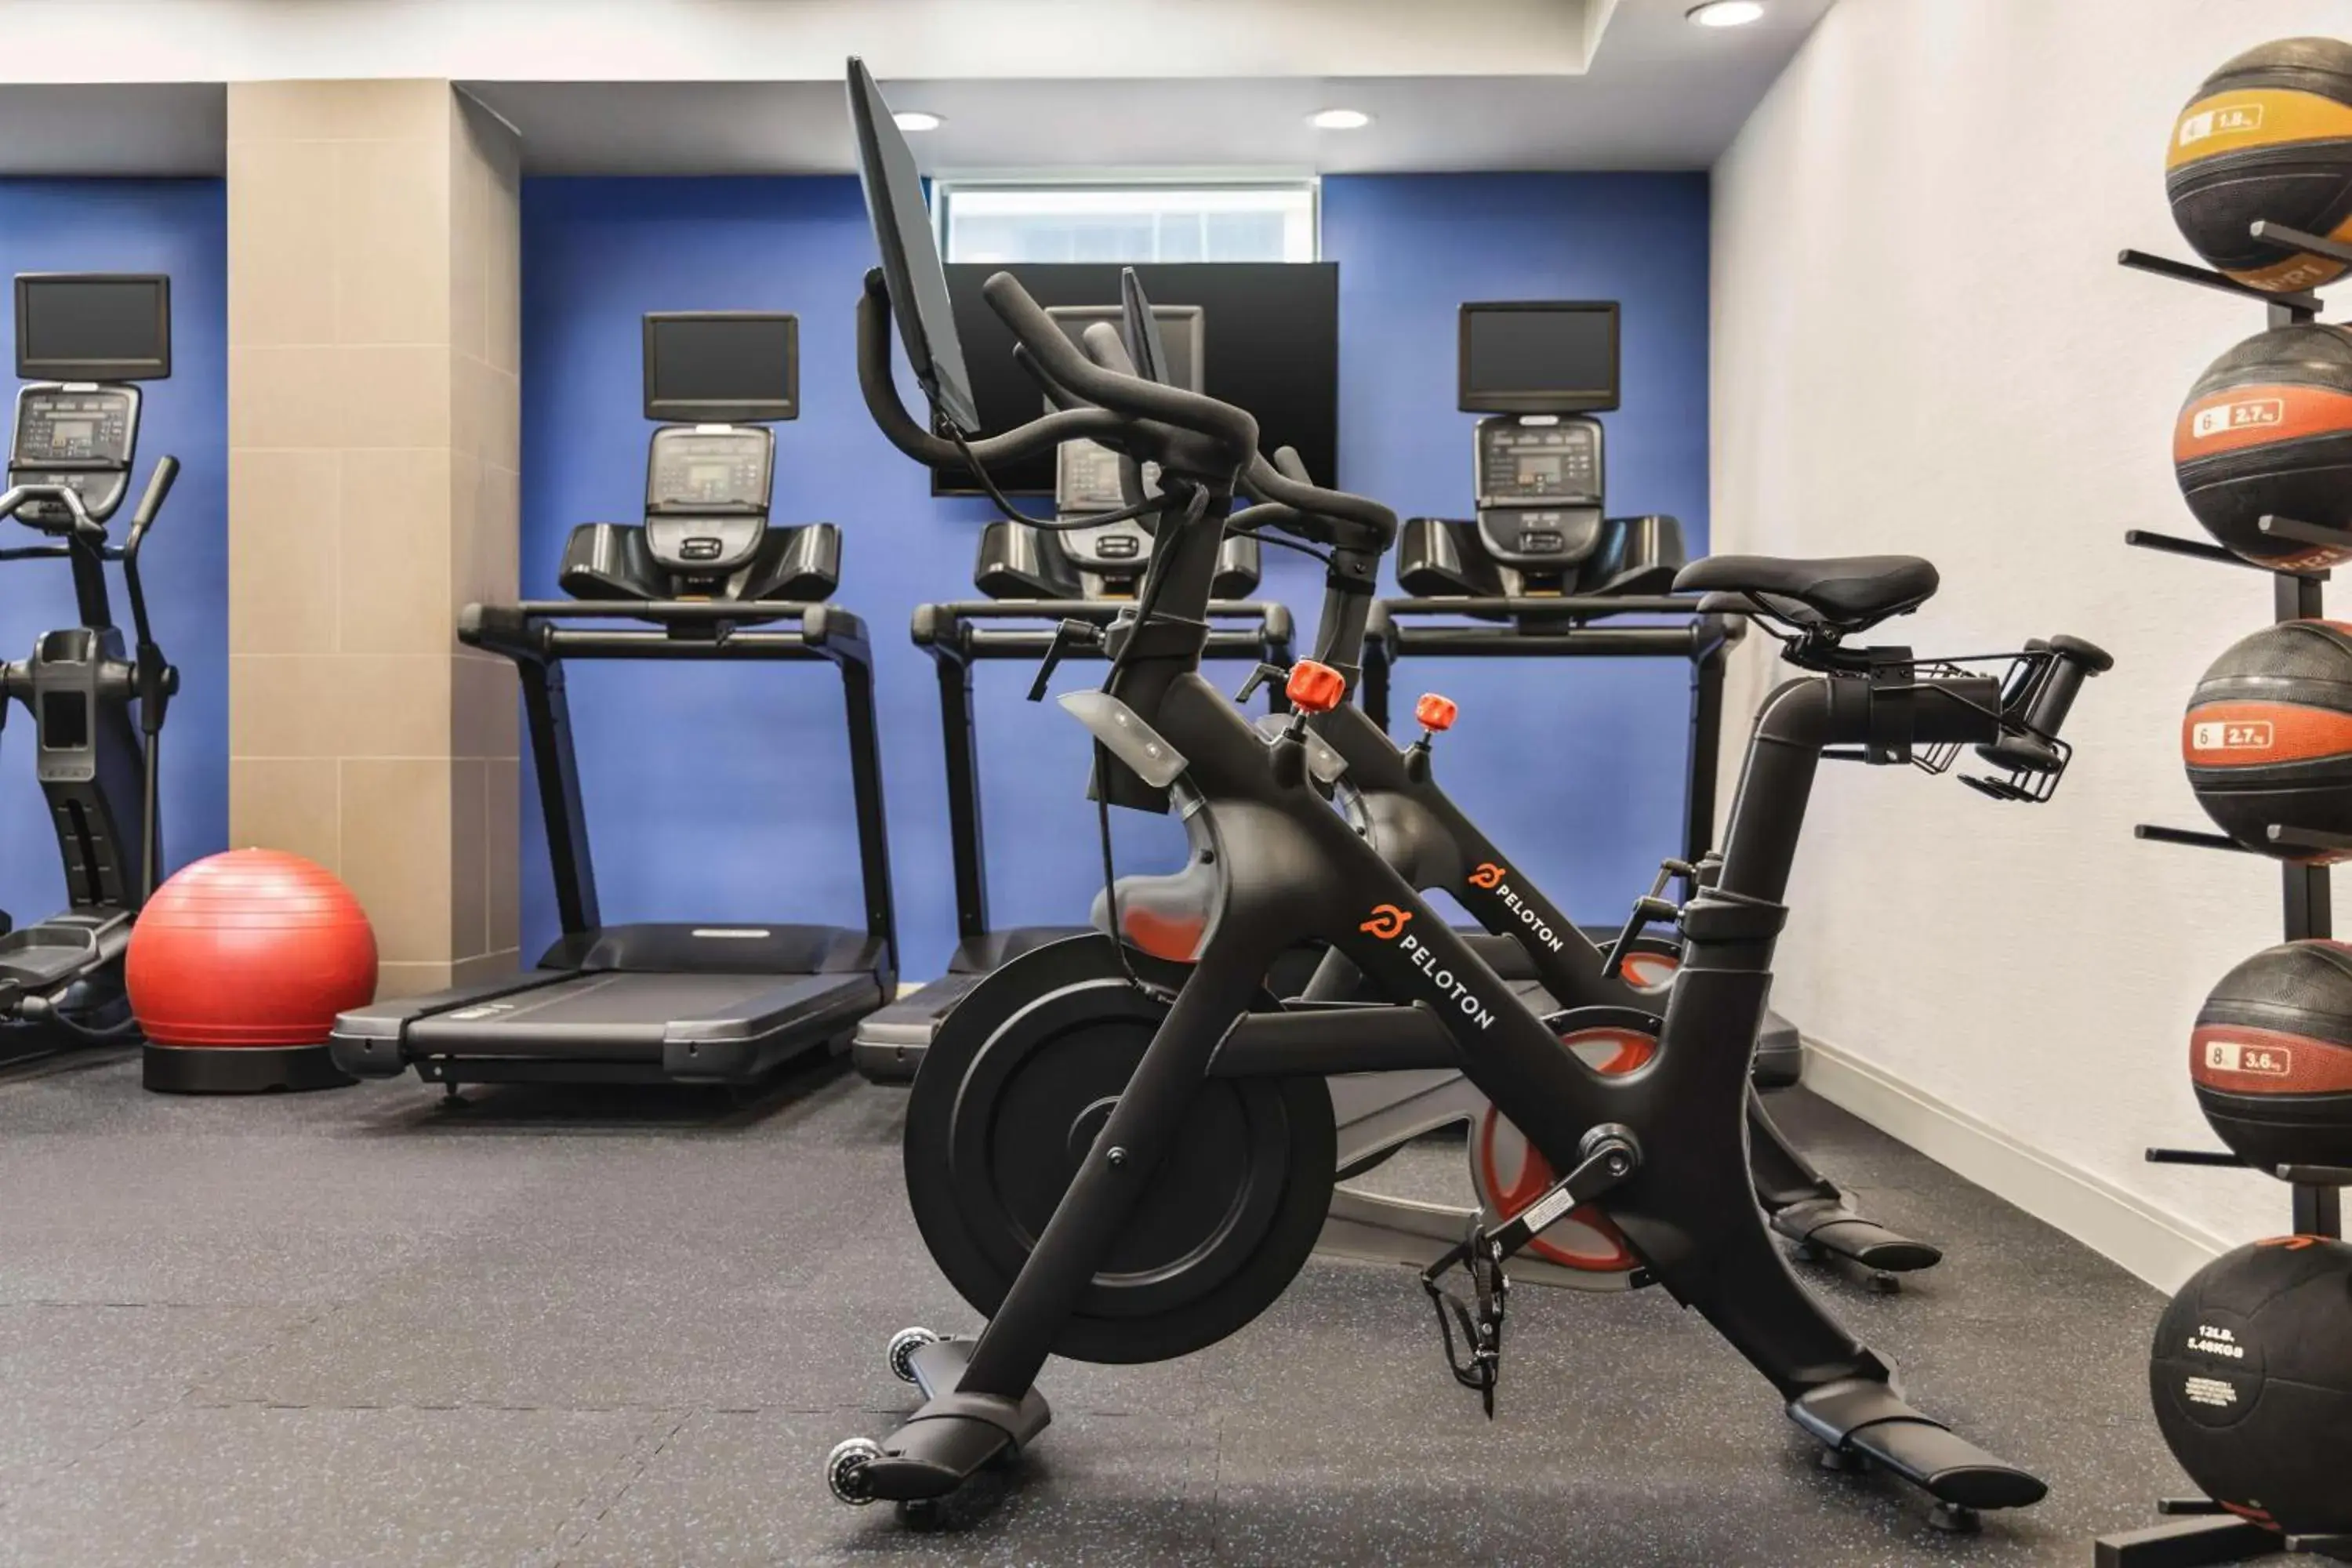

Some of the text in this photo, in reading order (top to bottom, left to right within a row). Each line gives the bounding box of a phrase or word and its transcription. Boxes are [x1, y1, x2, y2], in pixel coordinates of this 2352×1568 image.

[2200, 728, 2209, 746] 6
[1495, 884, 1564, 953] PELOTON
[1399, 934, 1496, 1030] PELOTON
[2213, 1047, 2223, 1065] 8
[2245, 1051, 2271, 1069] 3.6
